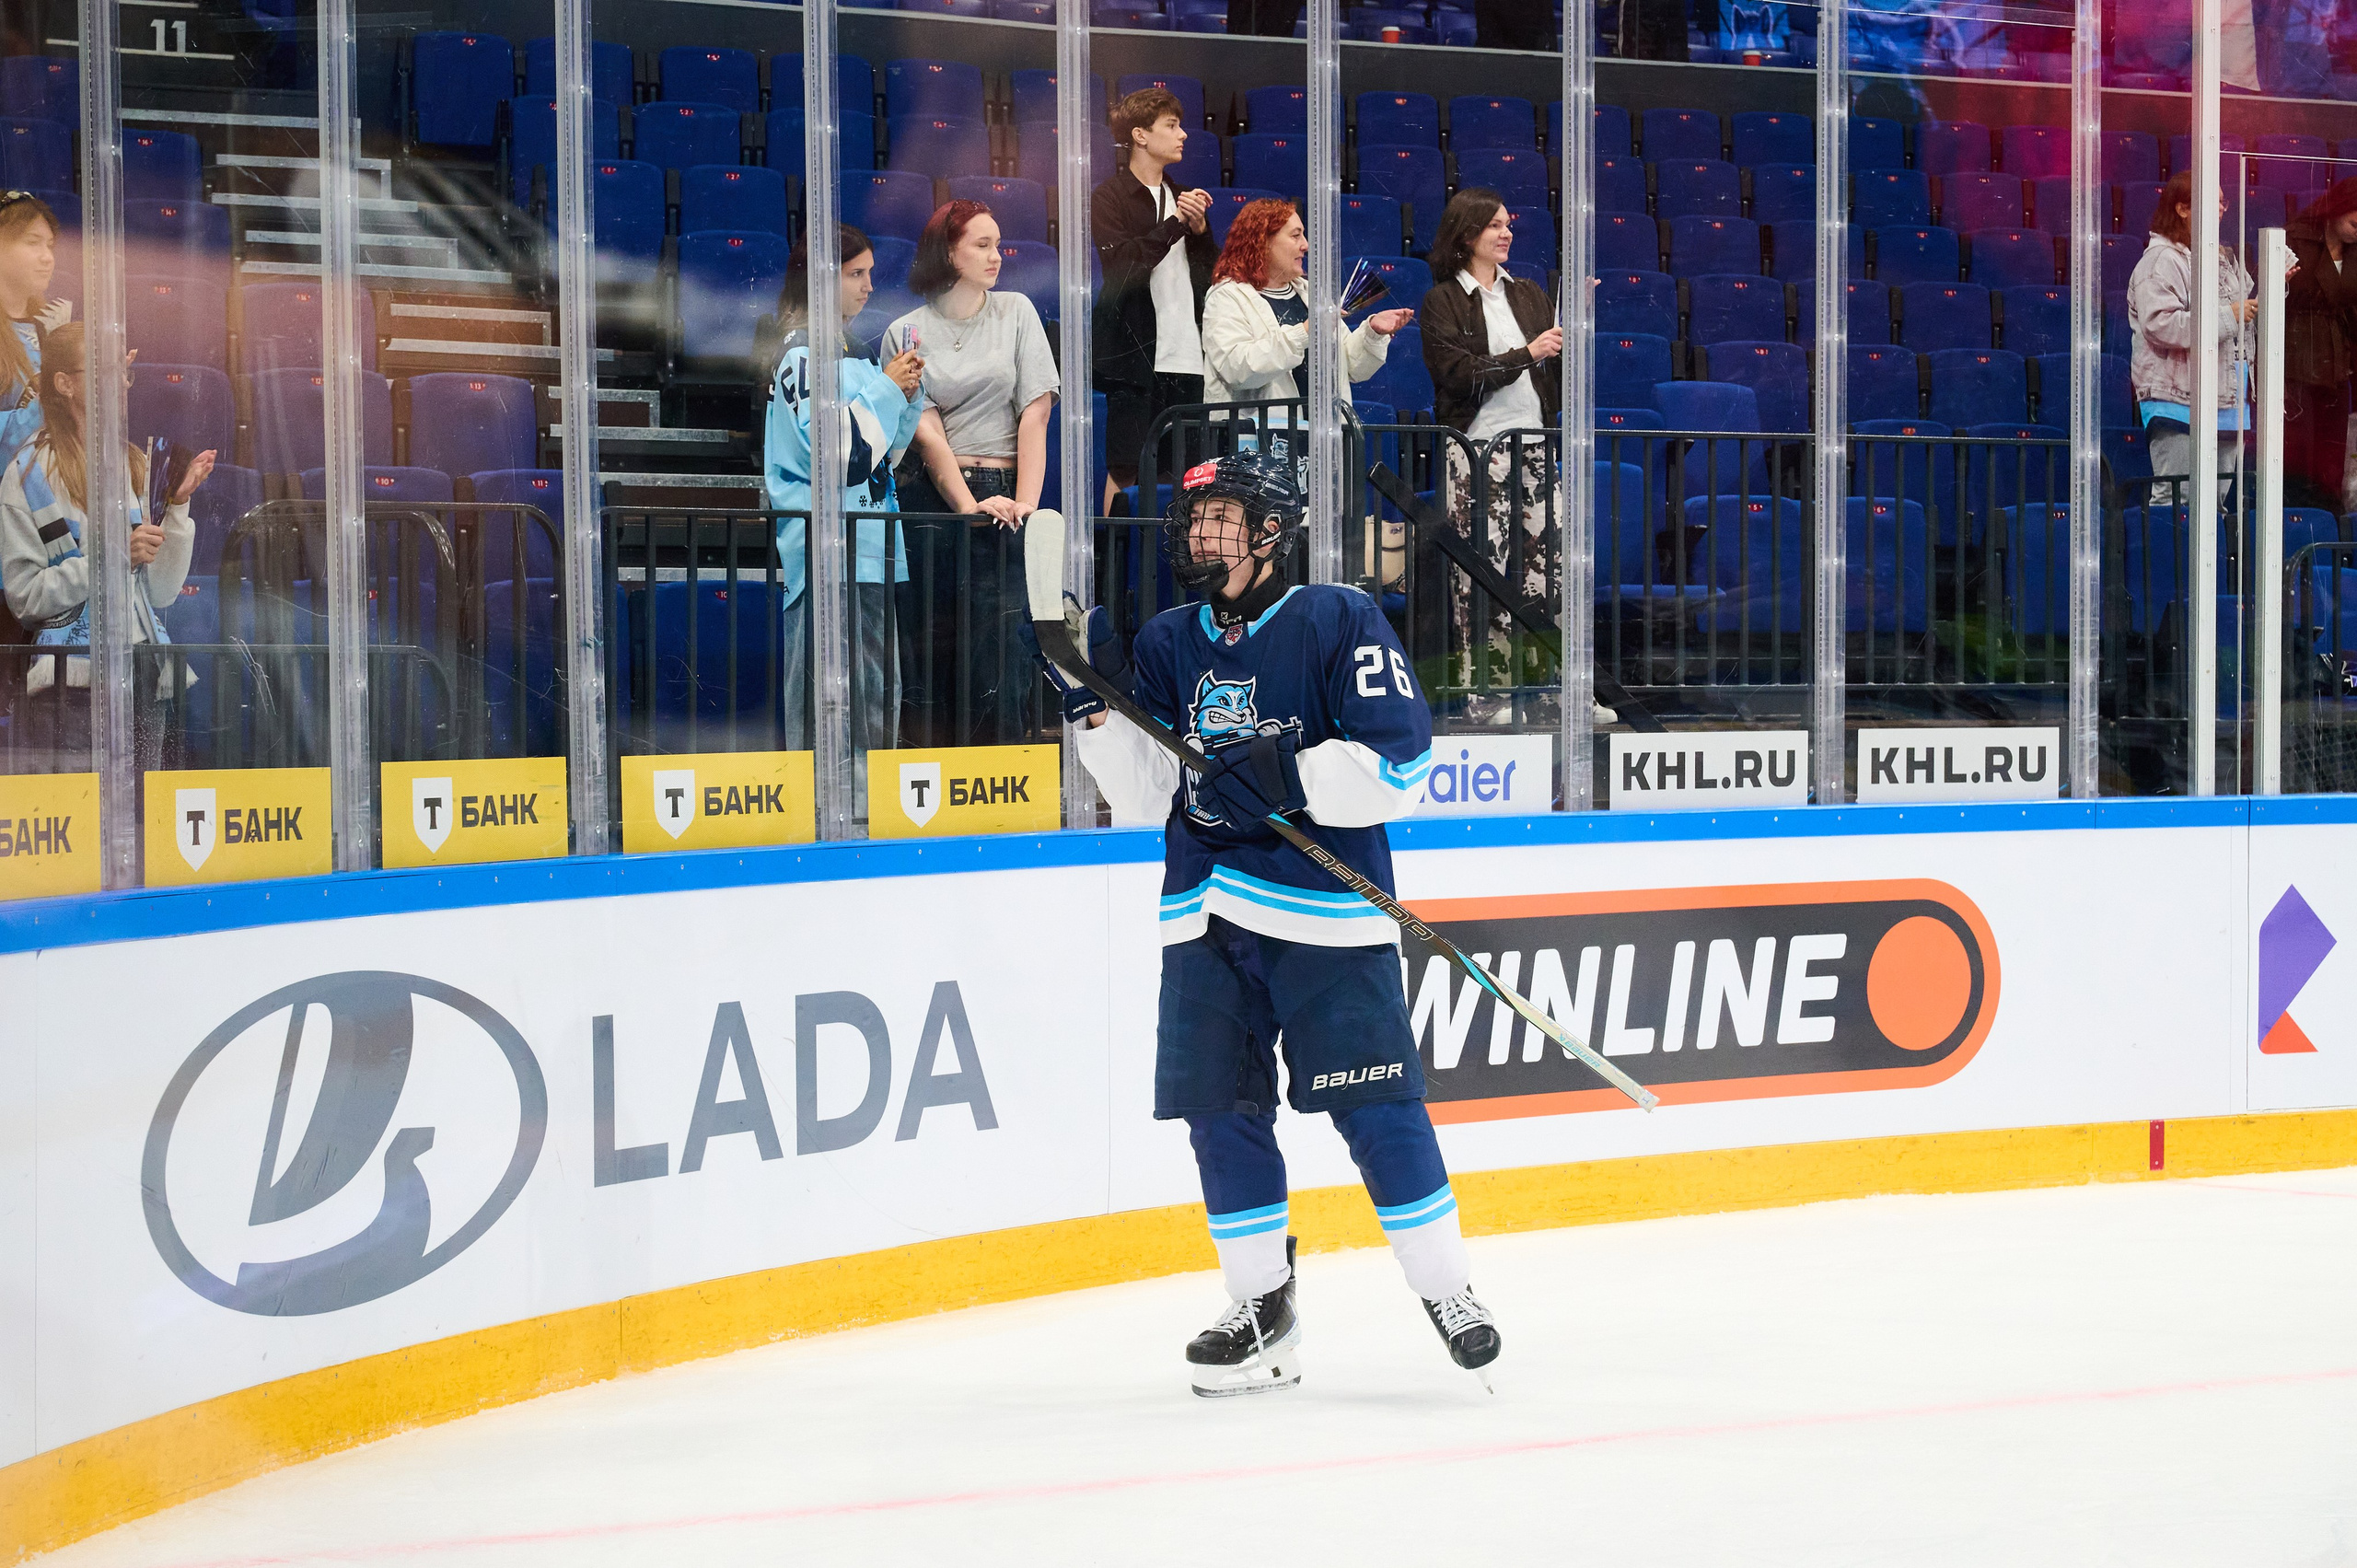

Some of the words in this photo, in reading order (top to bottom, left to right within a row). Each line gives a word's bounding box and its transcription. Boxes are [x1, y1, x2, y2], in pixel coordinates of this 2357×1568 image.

[150, 18, 187, 53] 11
[1183, 476, 1213, 487] OLIMPBET
[1353, 645, 1414, 700] 26
[1419, 749, 1515, 803] aier
[1622, 749, 1795, 791] KHL.RU
[1871, 746, 2047, 784] KHL.RU
[704, 784, 784, 816] БАНК
[949, 775, 1029, 806] БАНК
[225, 807, 303, 844] БАНК
[461, 793, 539, 828] БАНК
[1401, 934, 1846, 1070] WINLINE
[591, 981, 999, 1188] LADA
[1311, 1062, 1403, 1091] BAUER
[1248, 1329, 1274, 1352] BAER
